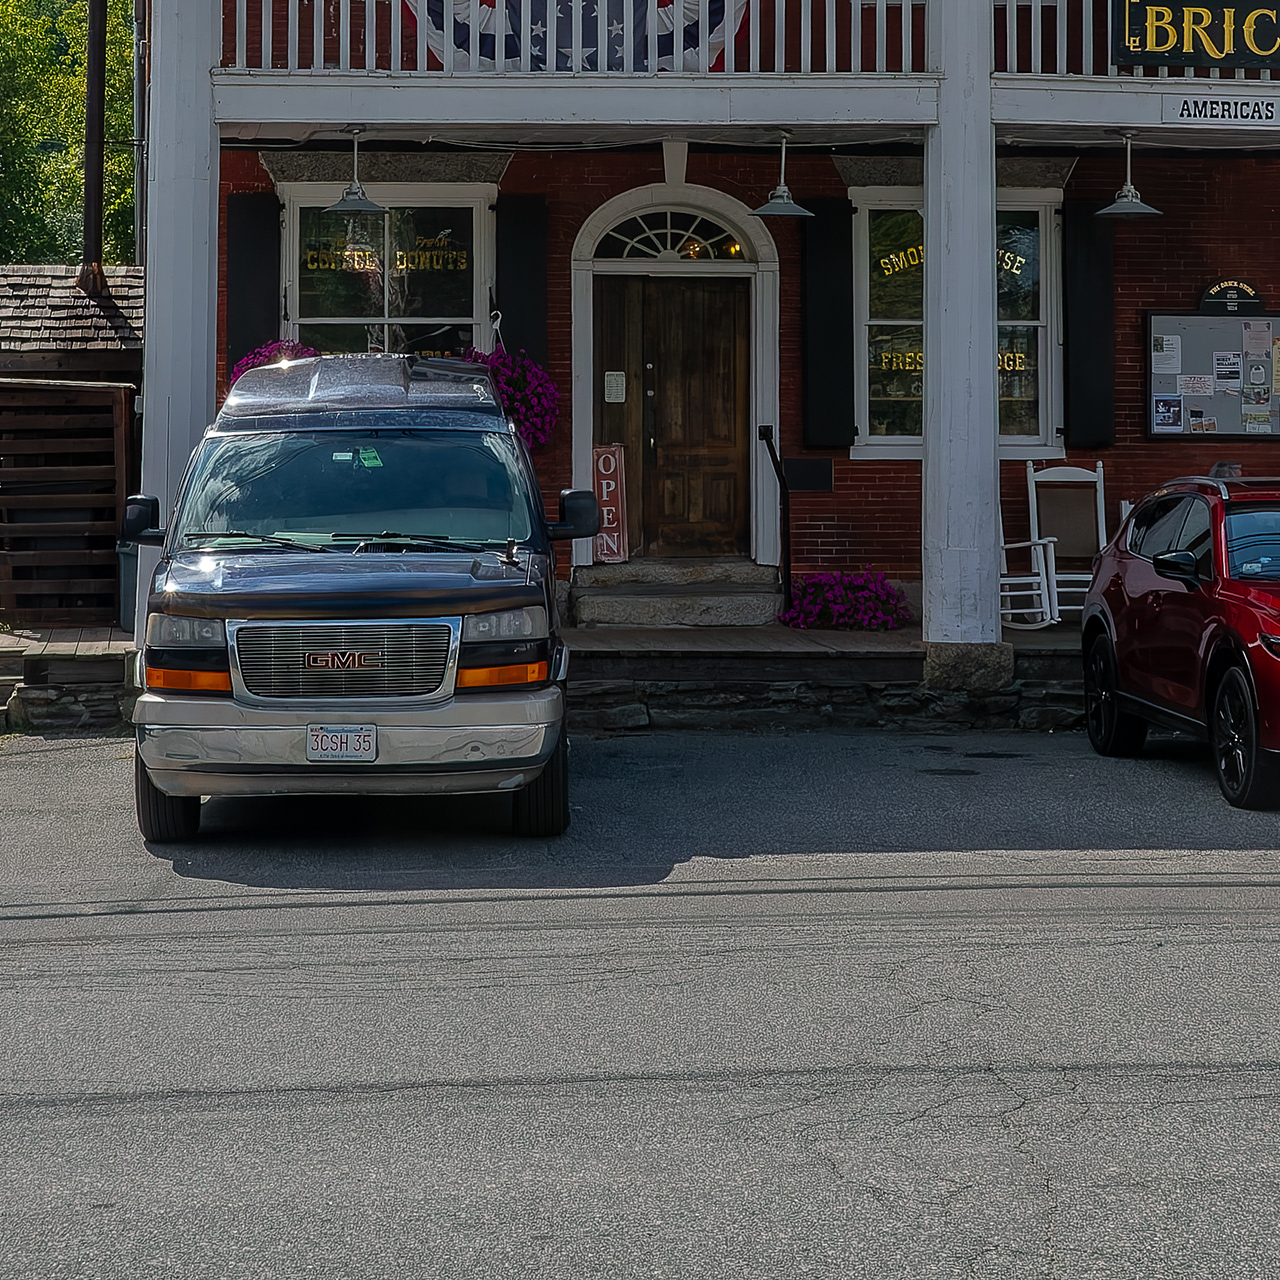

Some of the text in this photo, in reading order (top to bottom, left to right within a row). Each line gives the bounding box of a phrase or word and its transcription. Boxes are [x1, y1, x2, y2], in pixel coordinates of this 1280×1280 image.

[1179, 99, 1275, 121] AMERICA'S
[396, 250, 468, 270] DONUTS
[597, 453, 620, 554] OPEN
[305, 651, 382, 669] GMC
[311, 734, 372, 751] 3CSH 35
